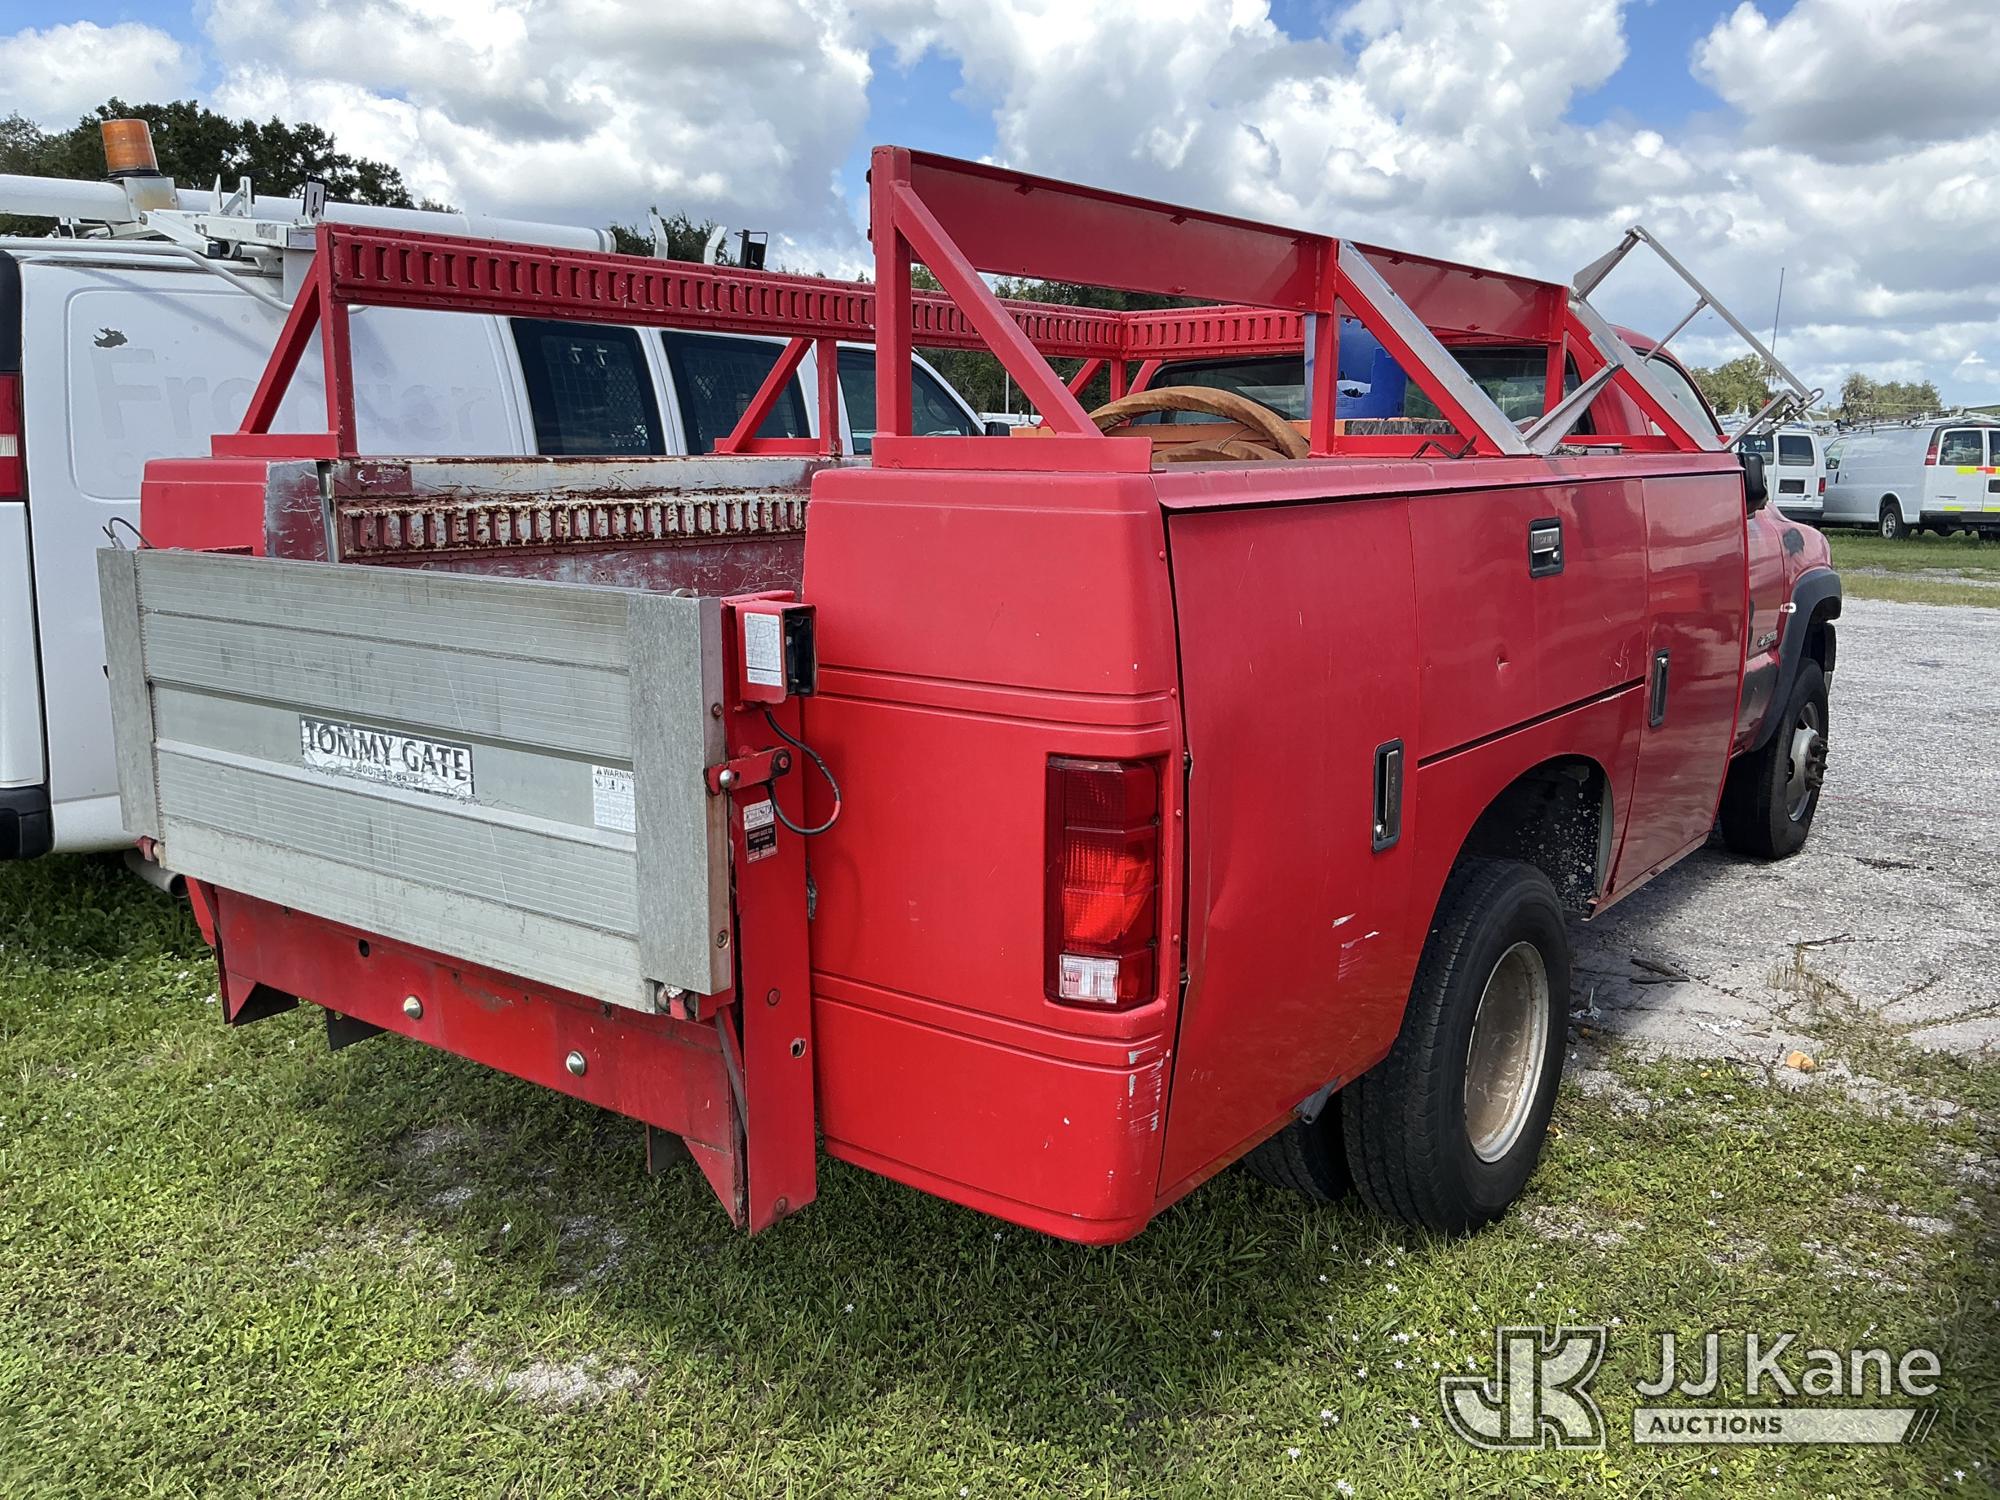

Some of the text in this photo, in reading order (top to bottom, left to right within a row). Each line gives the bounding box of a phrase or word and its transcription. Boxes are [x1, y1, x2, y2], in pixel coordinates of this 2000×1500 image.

[91, 347, 492, 443] Fronier
[305, 720, 468, 782] TOMMY GATE
